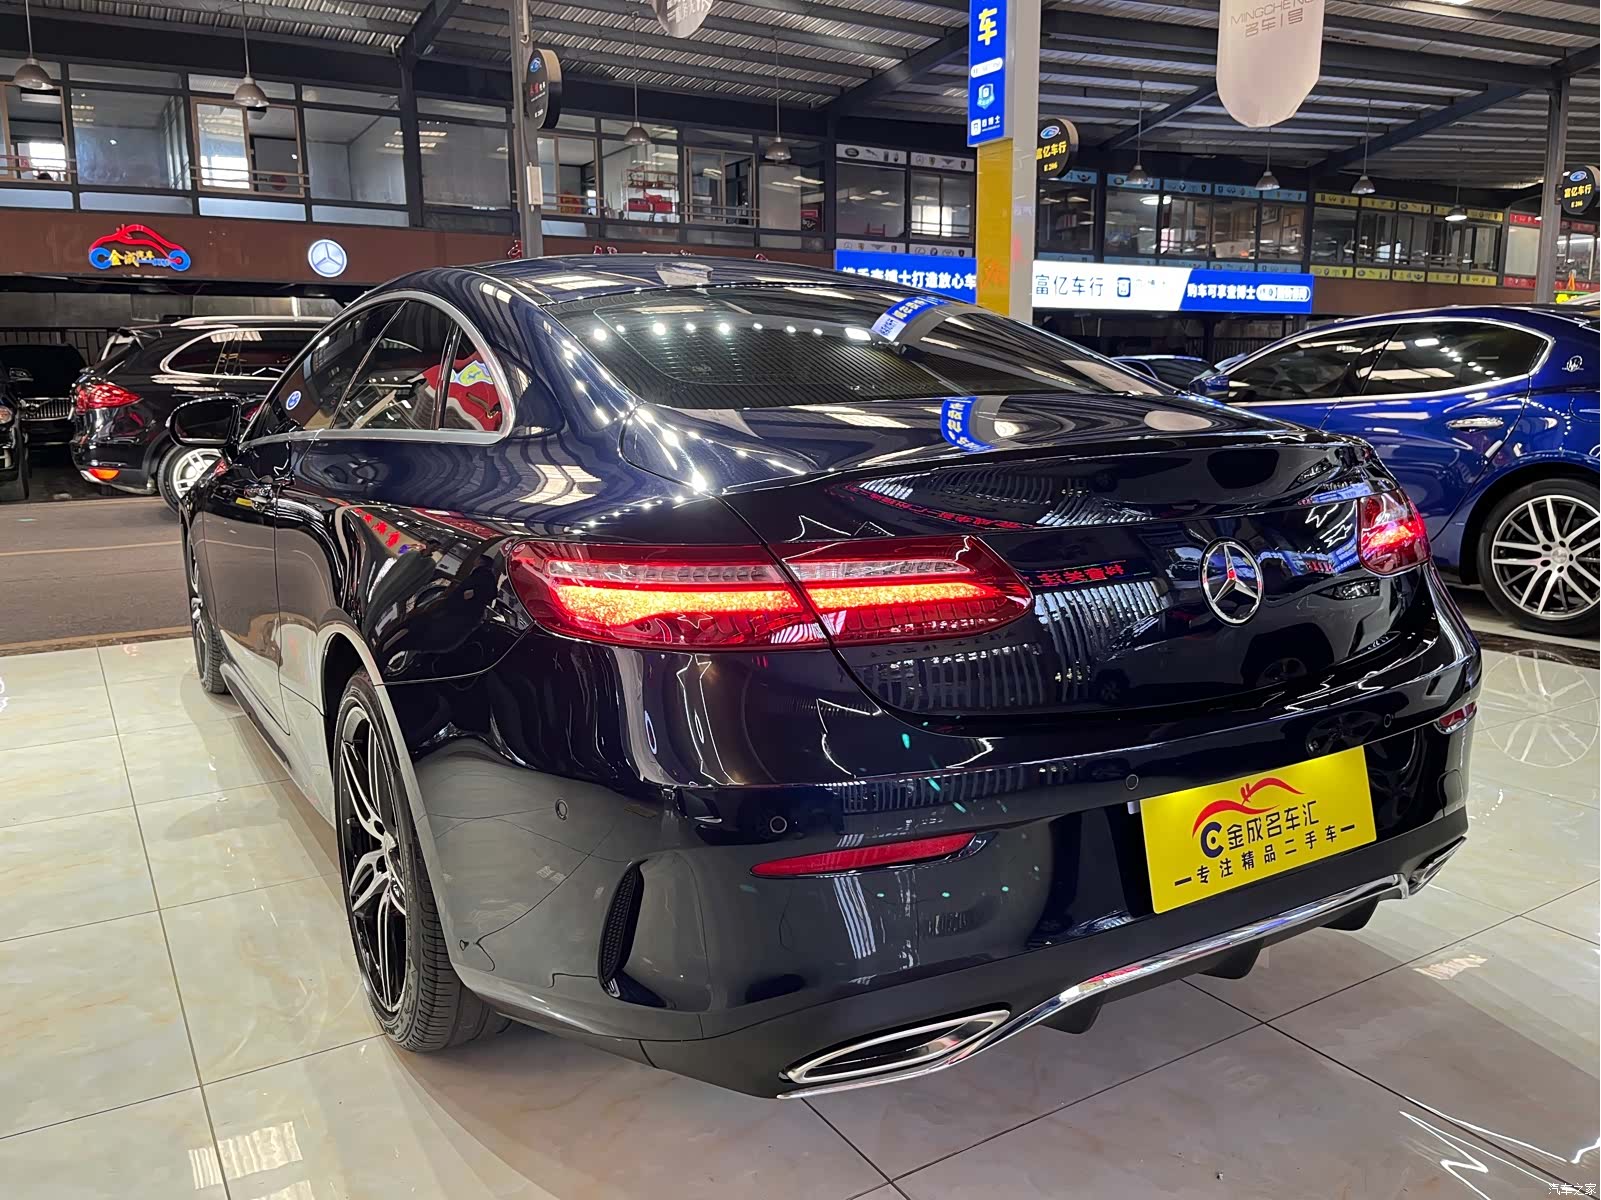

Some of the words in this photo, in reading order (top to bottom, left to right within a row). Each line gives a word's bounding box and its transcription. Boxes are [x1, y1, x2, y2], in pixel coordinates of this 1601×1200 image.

[1035, 274, 1104, 297] 富亿车行
[1226, 800, 1320, 851] 金成名车汇
[1196, 825, 1337, 884] 专注精品二手车
